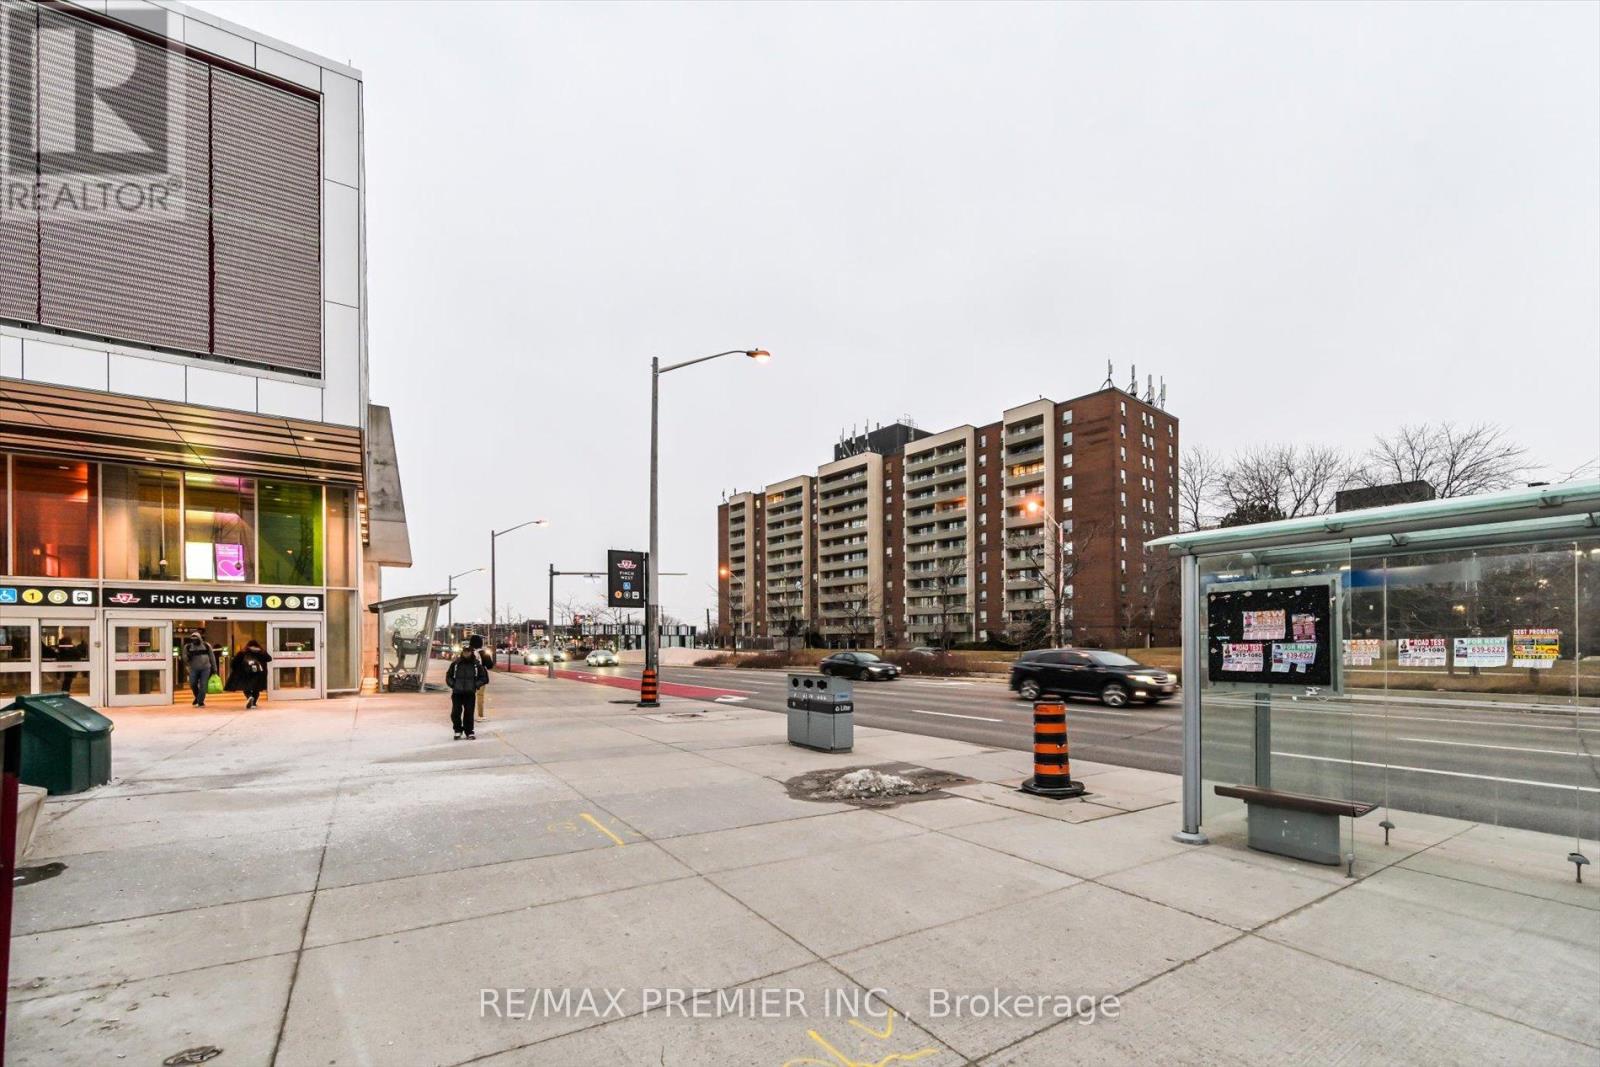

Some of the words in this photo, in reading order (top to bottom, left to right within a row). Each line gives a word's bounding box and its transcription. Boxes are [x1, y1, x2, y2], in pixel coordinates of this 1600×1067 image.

[151, 594, 196, 605] FINCH
[201, 596, 239, 606] WEST
[1235, 643, 1249, 651] ROAD
[1250, 643, 1263, 651] TEST
